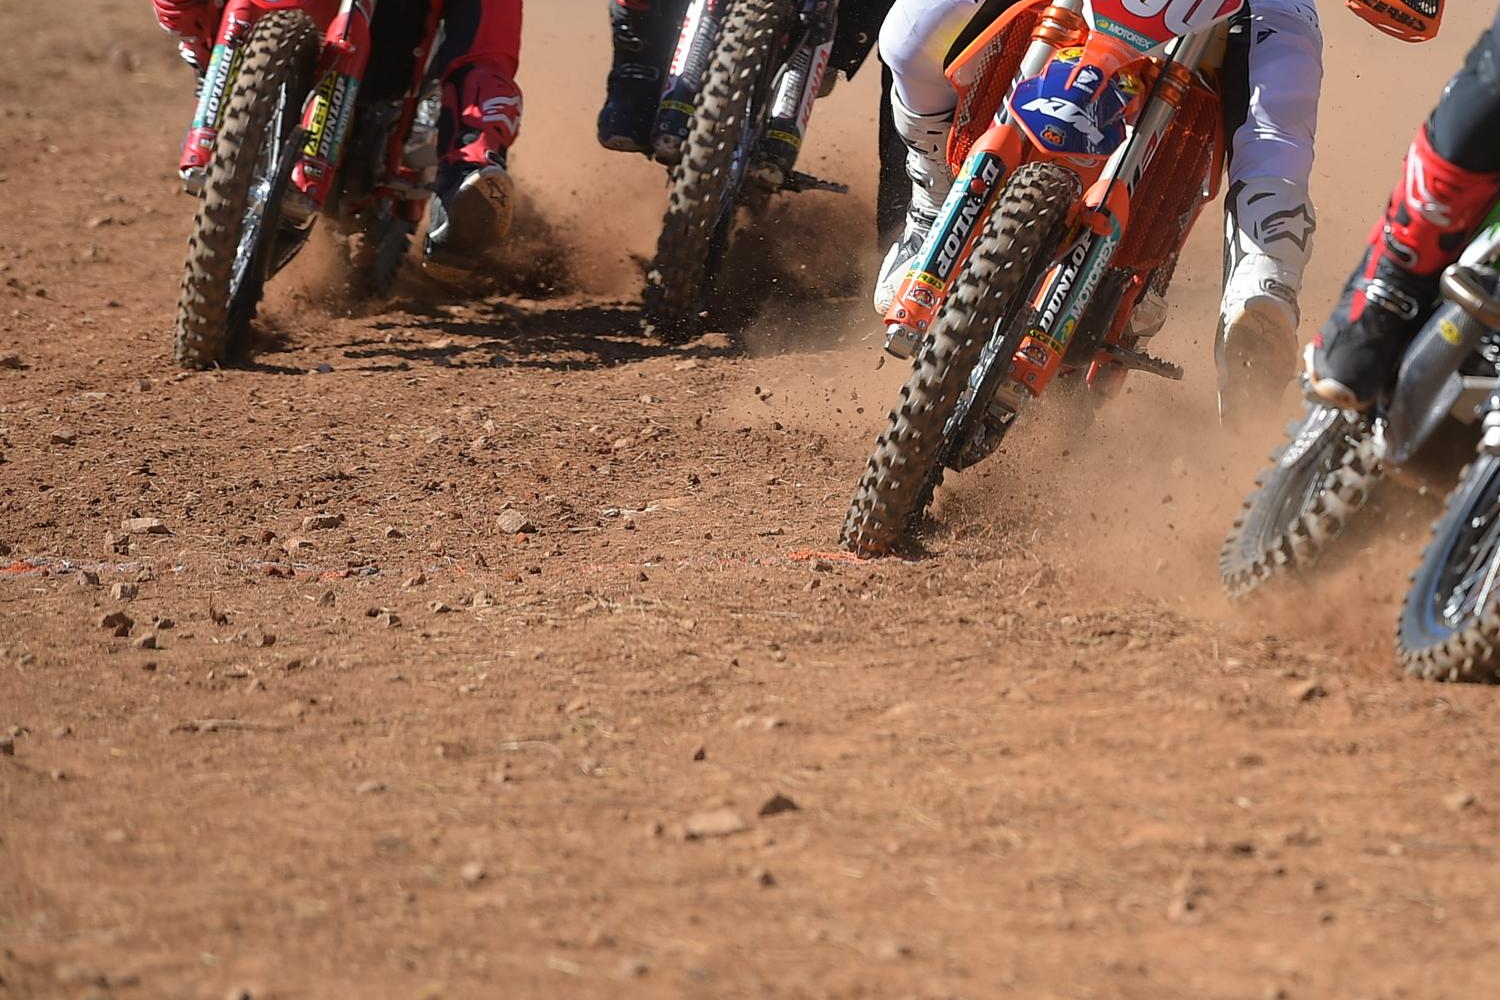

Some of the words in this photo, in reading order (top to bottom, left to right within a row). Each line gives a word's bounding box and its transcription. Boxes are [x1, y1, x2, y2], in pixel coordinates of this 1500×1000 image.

[1107, 24, 1151, 49] MOTOREX
[206, 46, 234, 125] DUNLOP
[319, 77, 346, 157] DUNLOP
[1021, 97, 1104, 145] KTM
[1039, 229, 1092, 333] DUNLOP
[1071, 236, 1118, 320] MOTOREX
